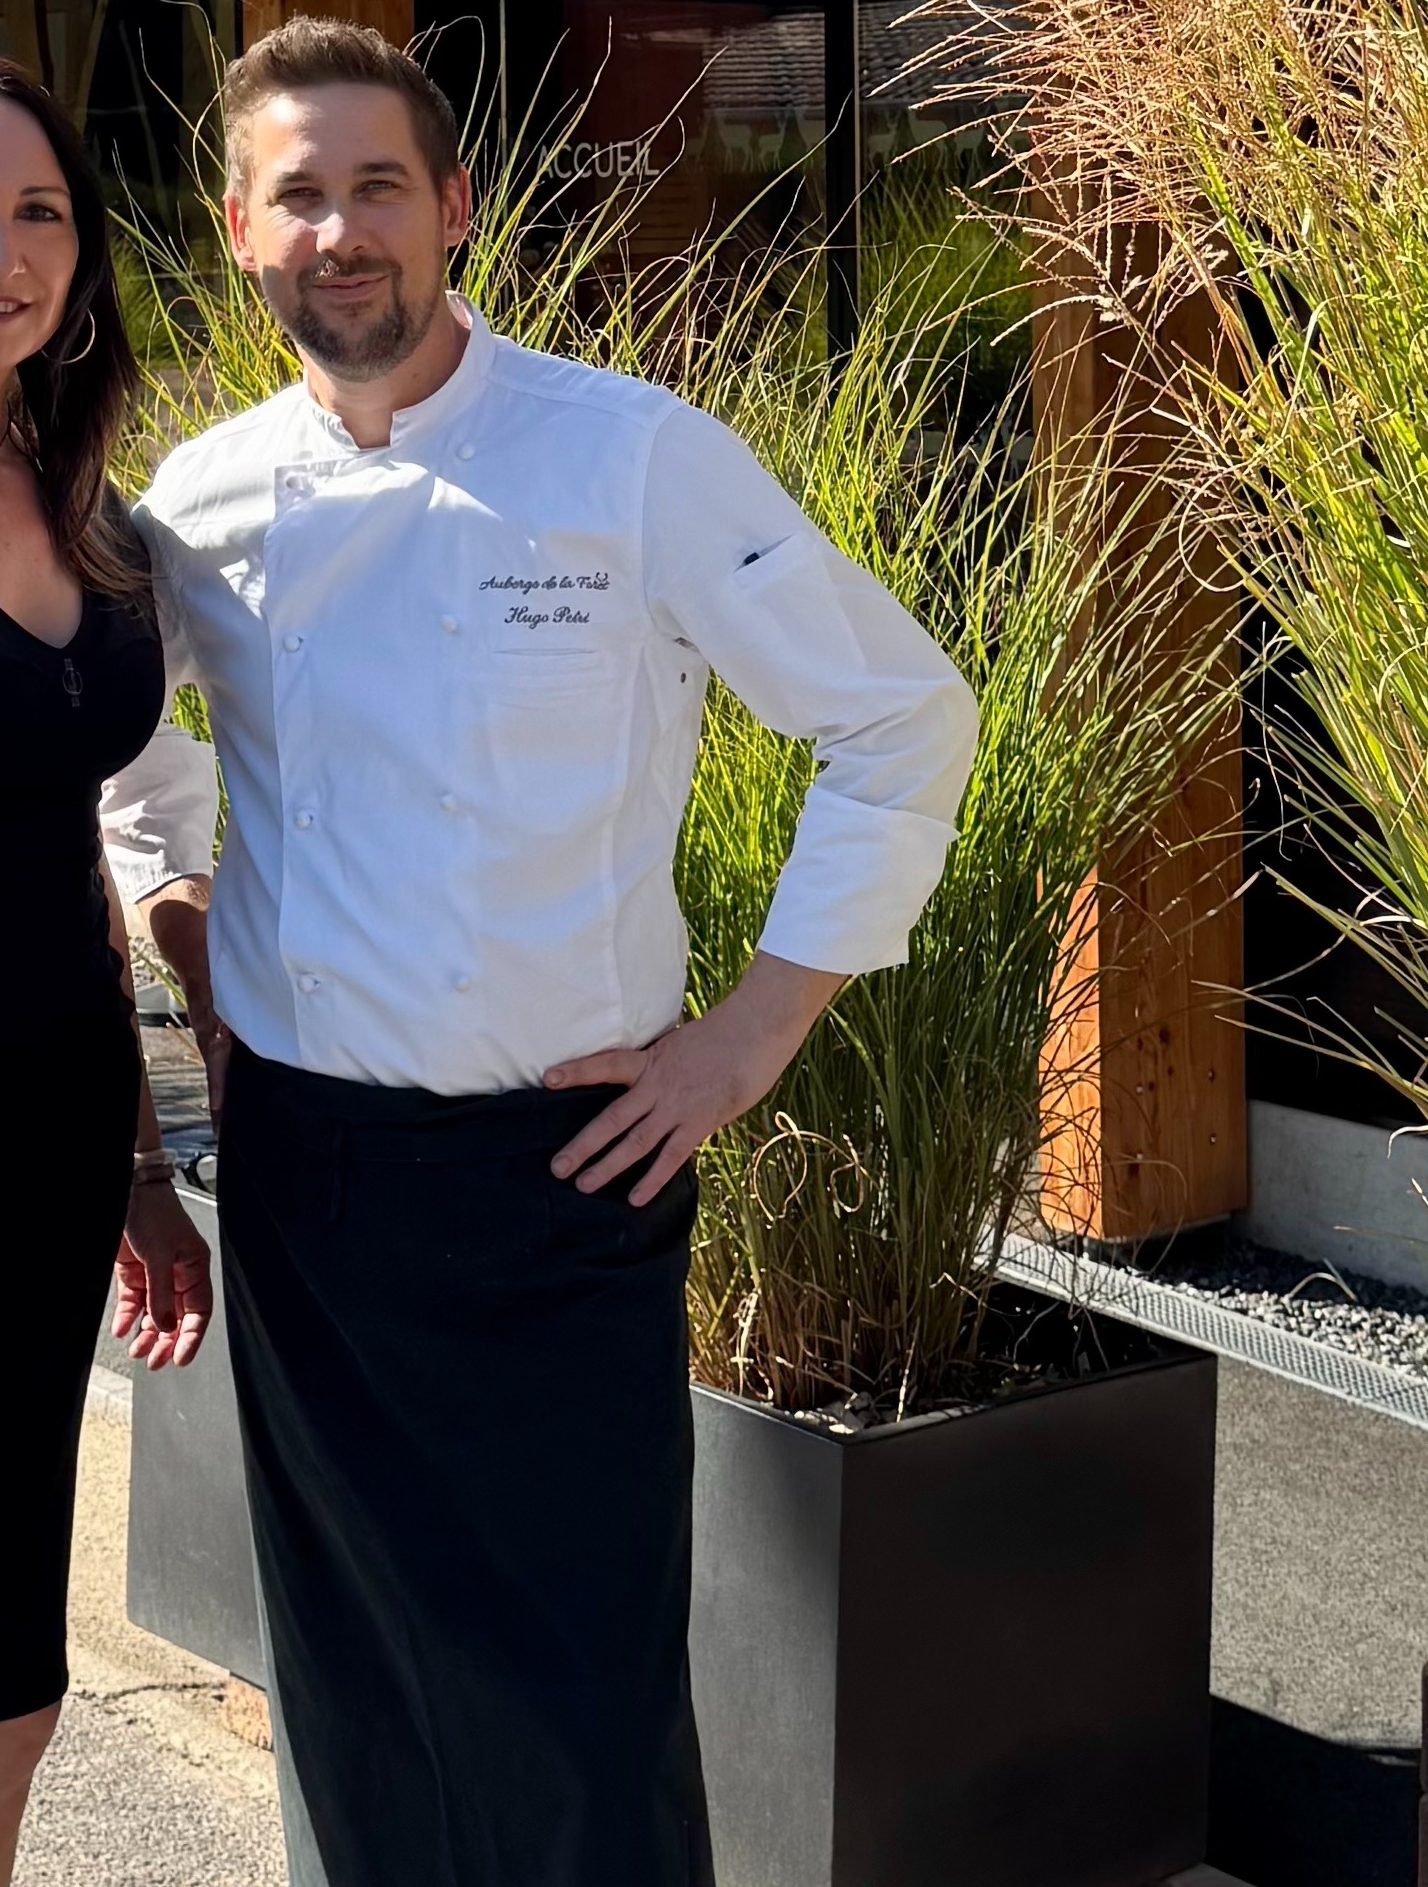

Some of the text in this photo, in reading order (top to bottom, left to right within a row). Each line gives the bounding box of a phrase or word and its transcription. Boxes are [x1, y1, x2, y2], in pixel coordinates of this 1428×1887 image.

[536, 141, 661, 180] ACCUEIL
[478, 574, 540, 595] Auberge
[541, 575, 558, 591] de
[558, 575, 575, 589] la
[503, 605, 549, 630] Hugo
